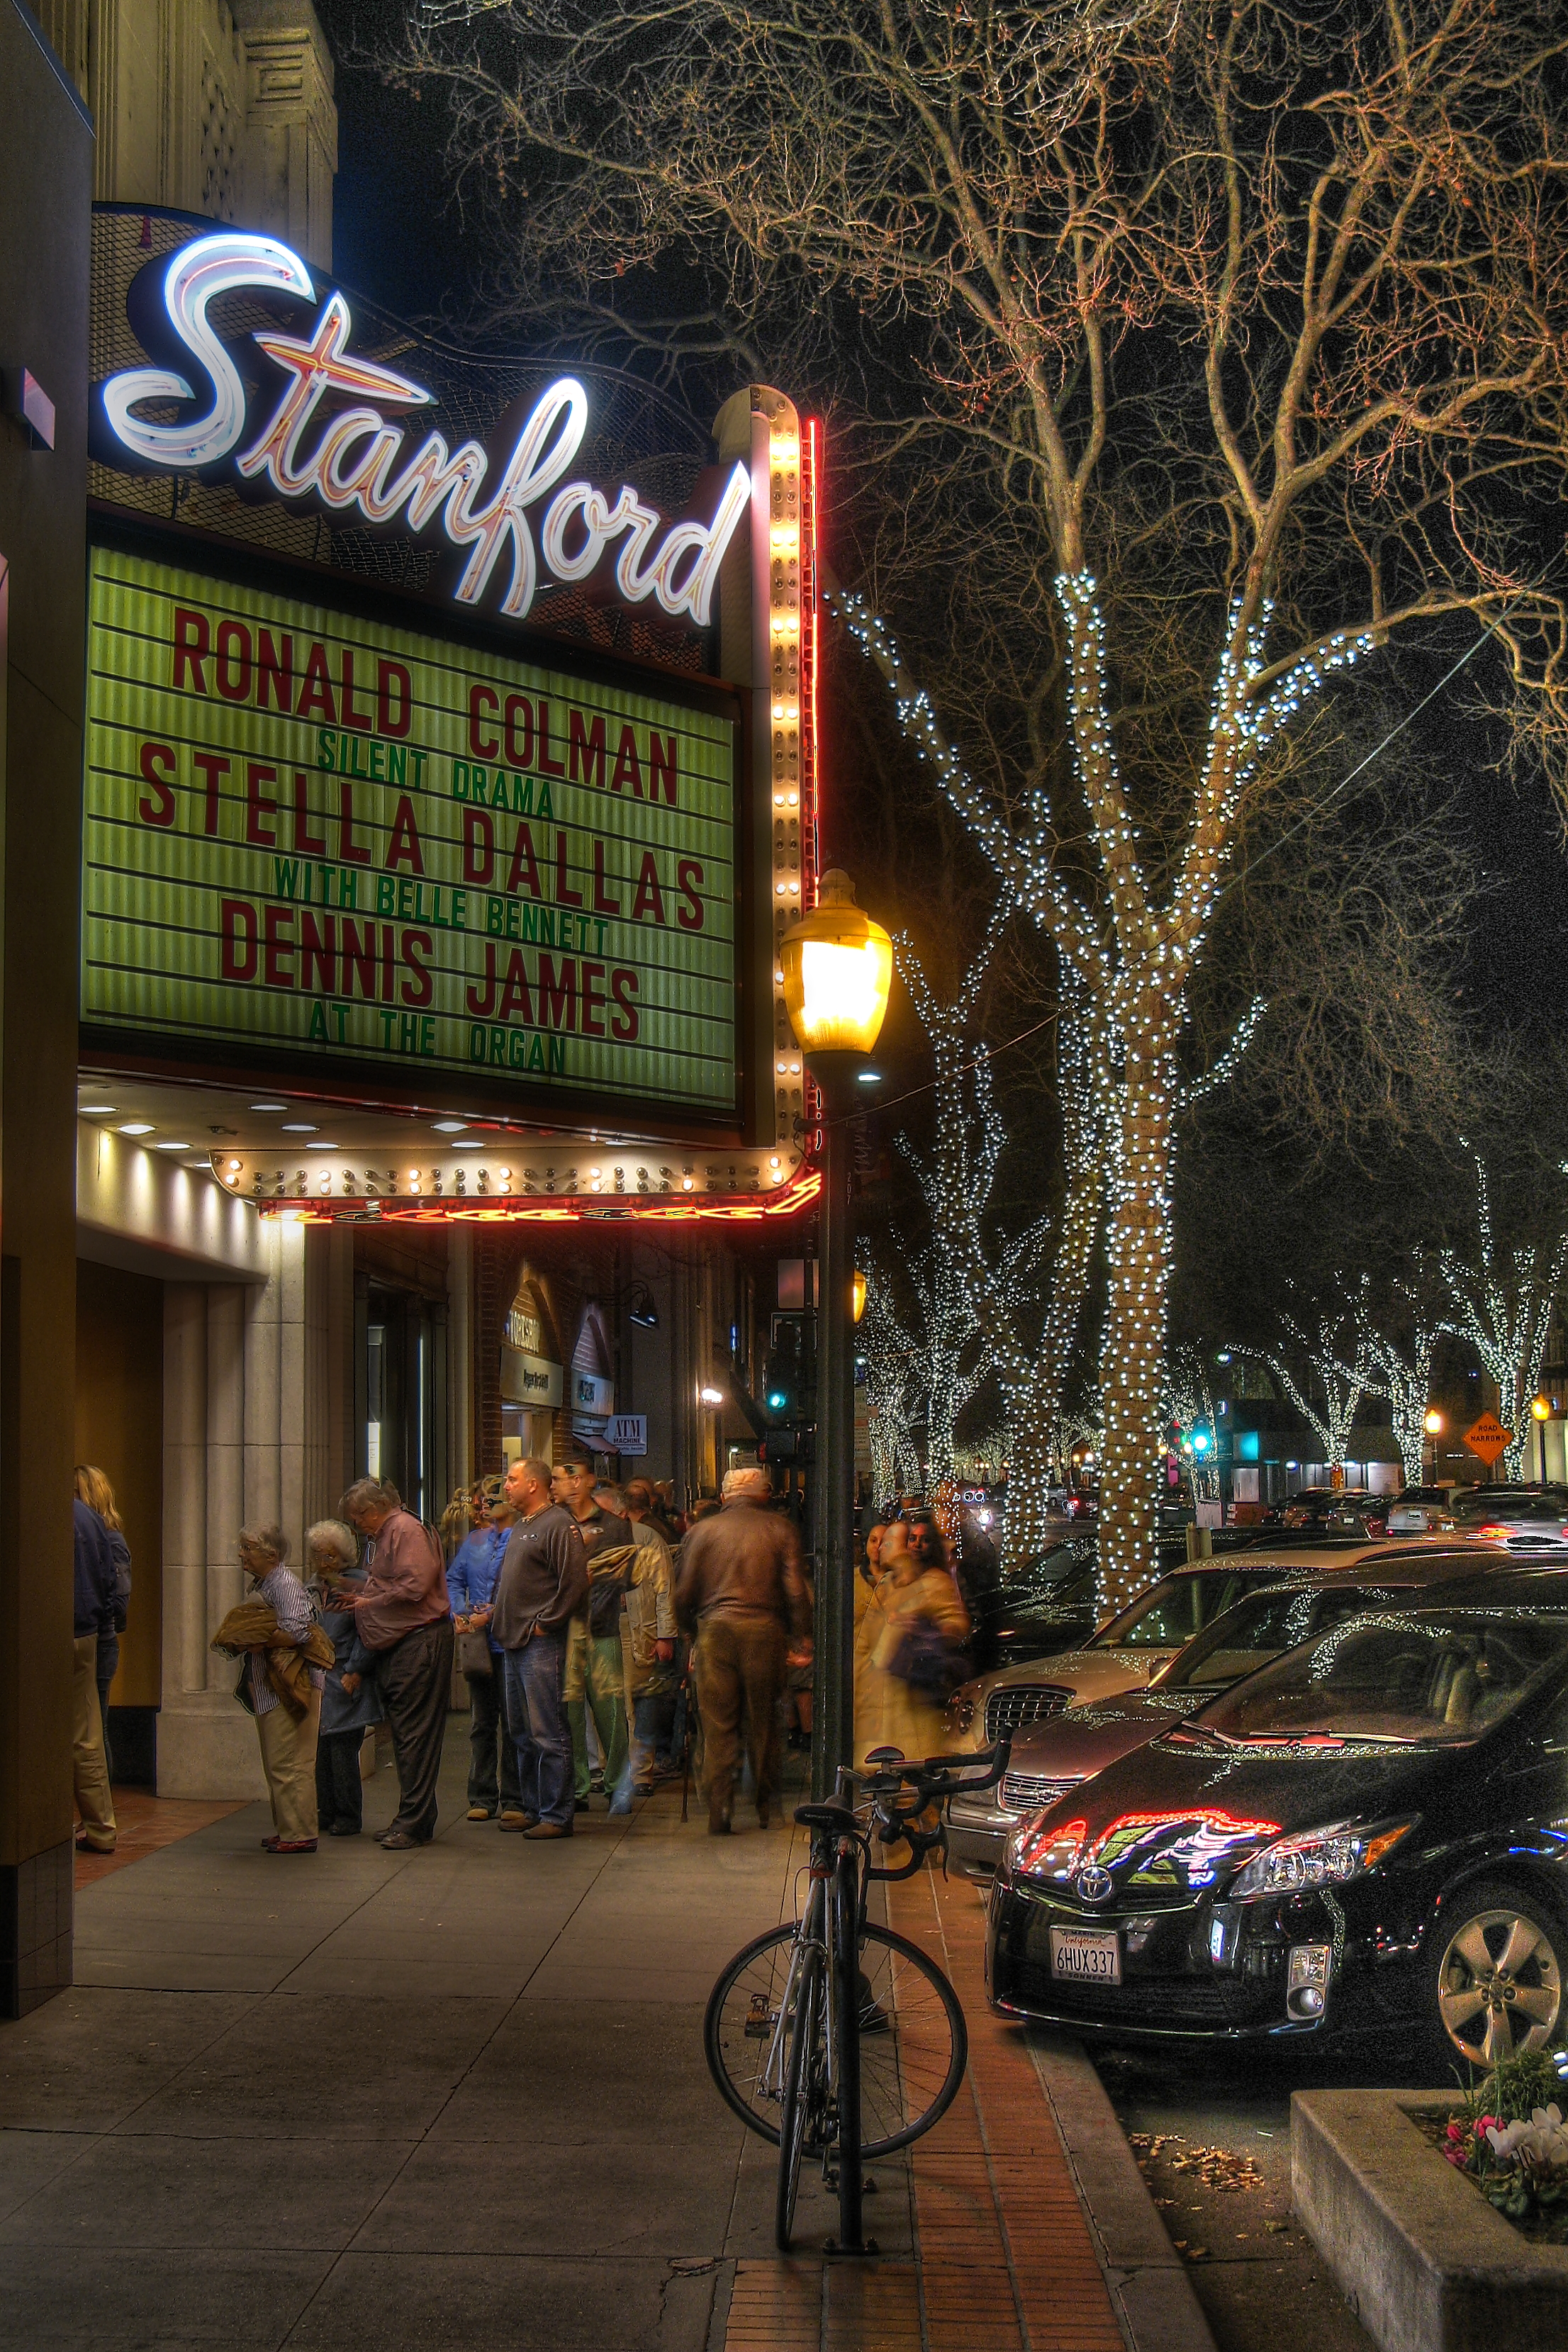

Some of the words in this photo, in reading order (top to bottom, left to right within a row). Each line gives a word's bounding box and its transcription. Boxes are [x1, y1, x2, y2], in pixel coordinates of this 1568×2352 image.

[103, 233, 751, 627] Stanford
[172, 606, 411, 739] RONALD
[469, 683, 677, 806] COLMAN
[318, 729, 427, 788] SILENT
[453, 760, 554, 819] DRAMA
[139, 741, 424, 875] STELLA
[463, 807, 704, 930] DALLAS
[274, 856, 357, 909] WITH
[378, 877, 466, 928] BELLE
[488, 897, 608, 956] BENNETT
[220, 898, 433, 1007] DENNIS
[466, 942, 639, 1041] JAMES
[309, 1001, 351, 1044] AT
[379, 1012, 436, 1055] THE
[470, 1024, 565, 1075] ORGAN
[614, 1419, 640, 1438] ATM
[1057, 1947, 1114, 1975] 6HUX337
